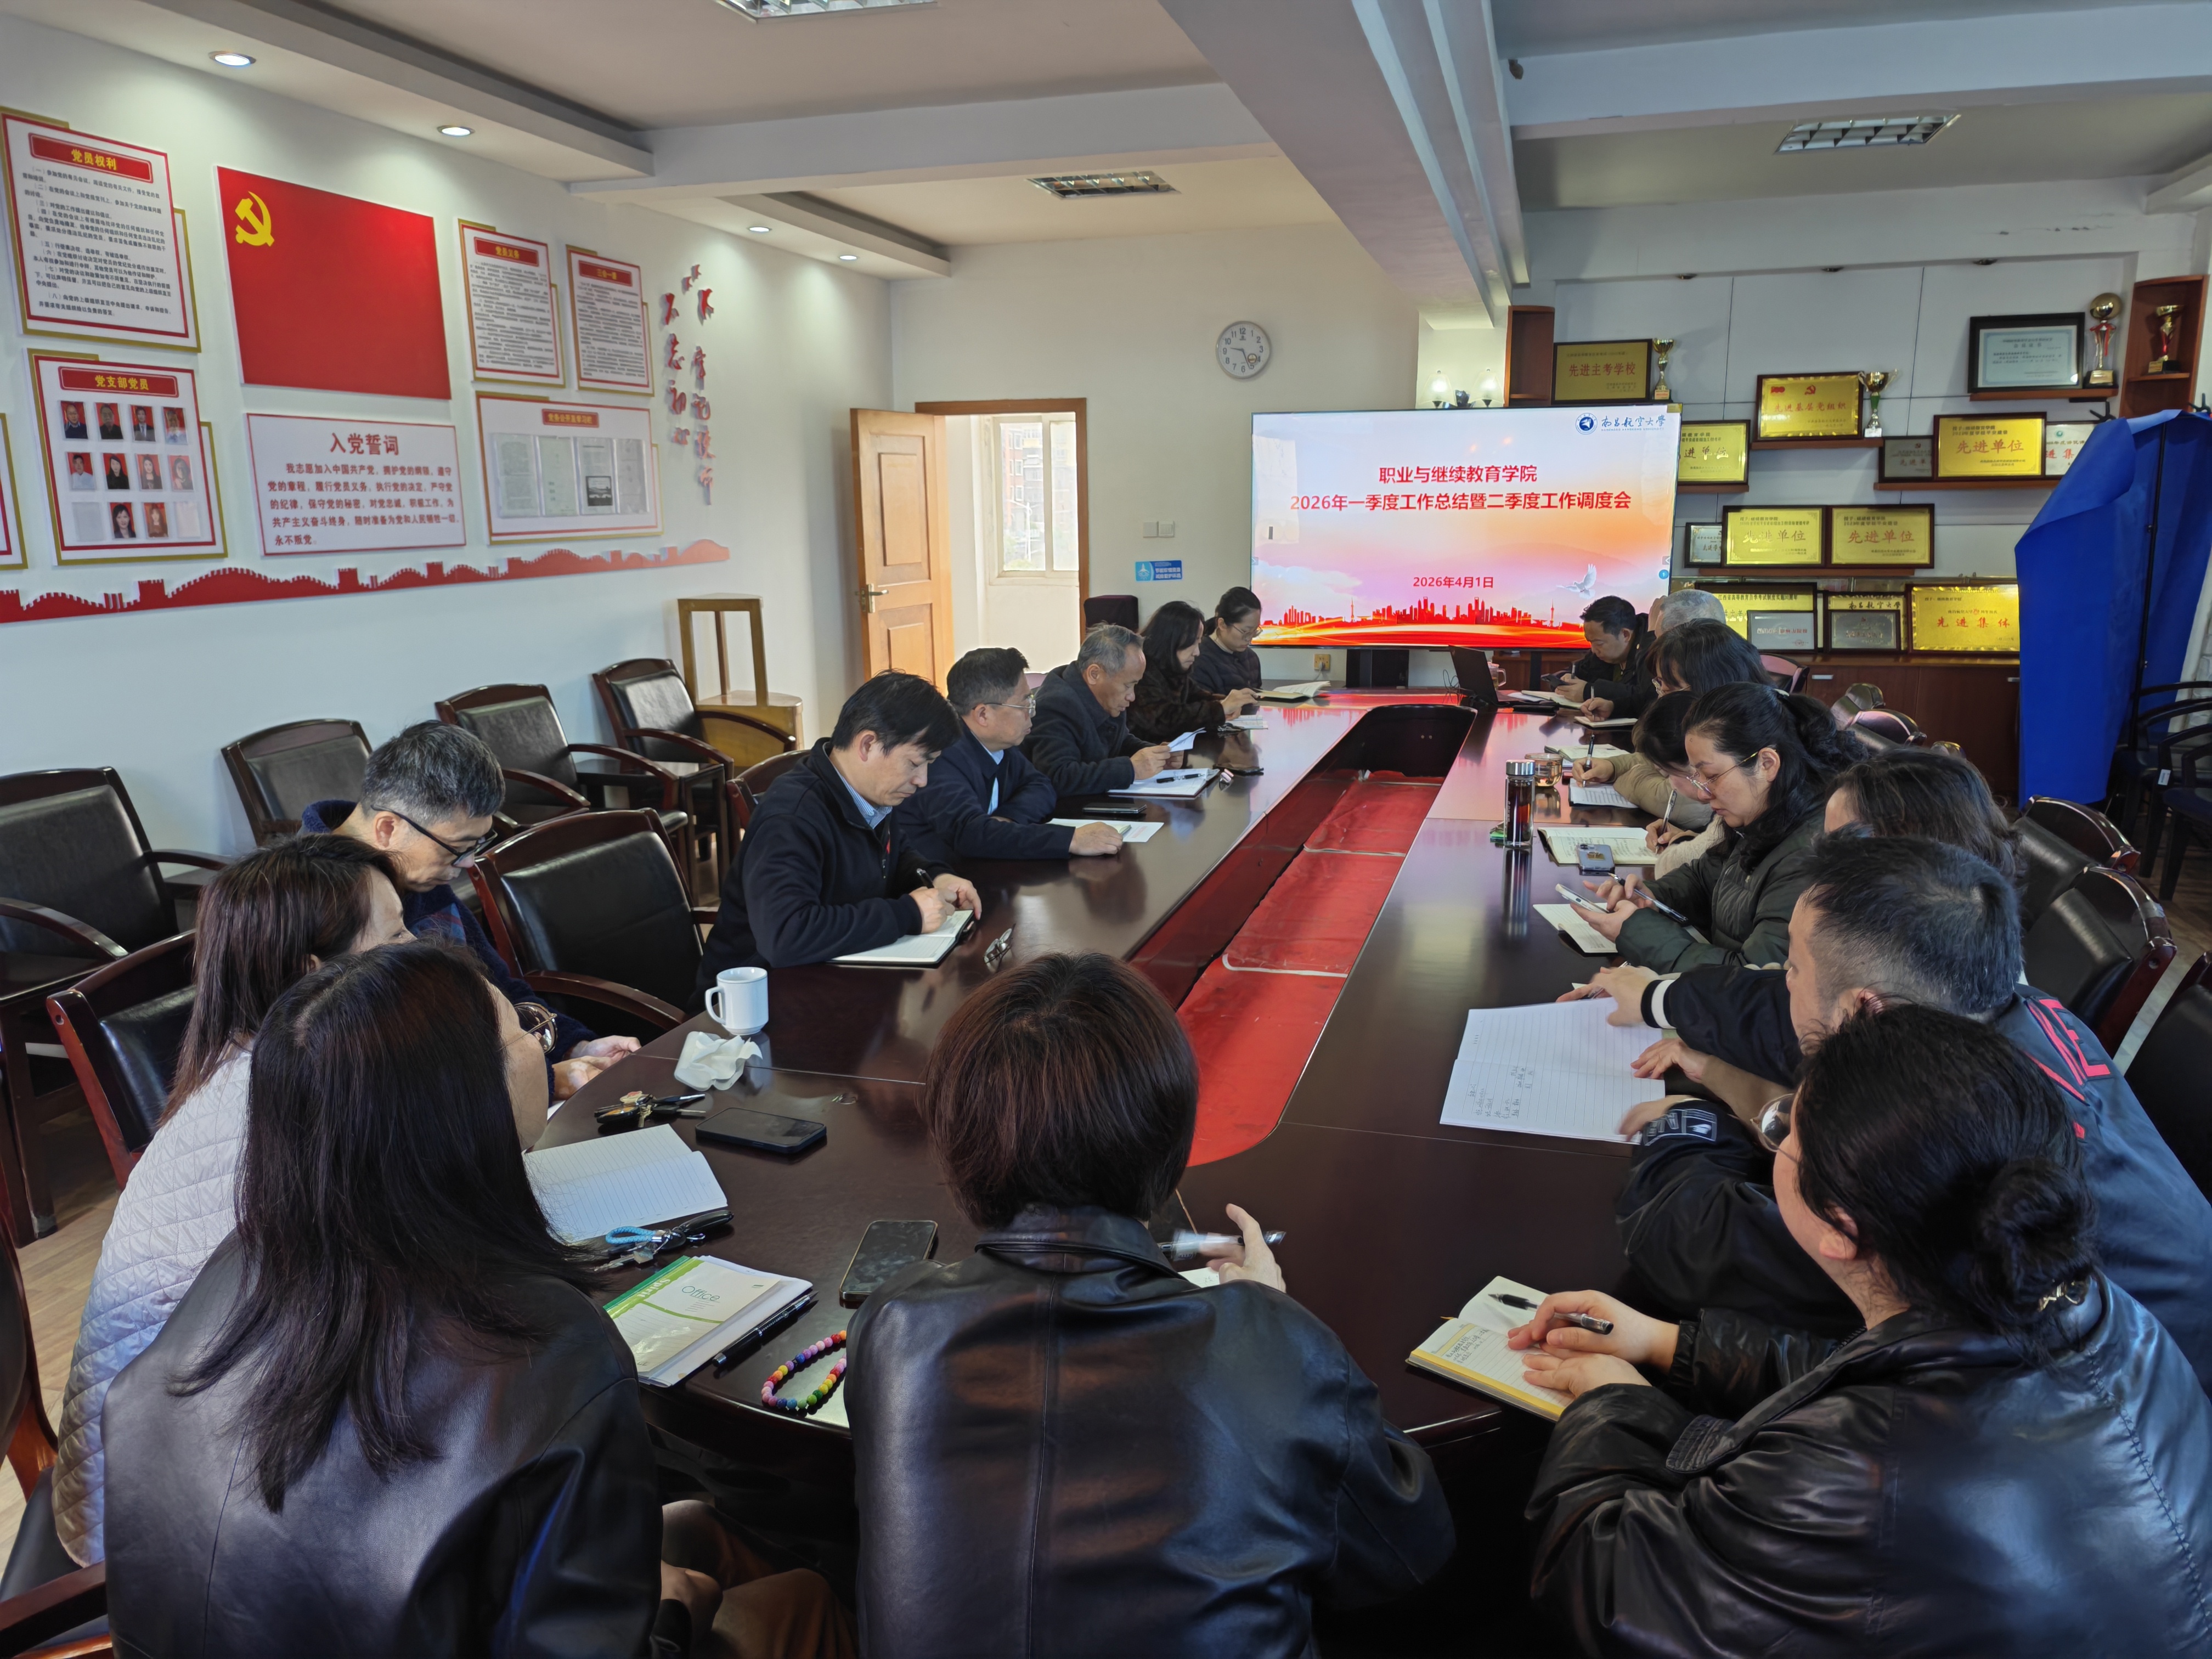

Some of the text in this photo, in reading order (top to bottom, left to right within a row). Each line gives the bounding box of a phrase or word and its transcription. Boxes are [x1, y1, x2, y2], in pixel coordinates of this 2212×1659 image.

[71, 149, 117, 171] 党员权利
[1569, 362, 1635, 377] 先进主考学校
[95, 375, 149, 391] 党支部党员
[1774, 402, 1847, 413] 先进基层党组织
[330, 432, 399, 455] 入党誓词
[1956, 439, 2024, 454] 先进单位
[1379, 464, 1538, 485] 职业与继续教育学院
[1290, 491, 1632, 513] 2026年一季度工作总结暨二季度工作调度会
[1743, 529, 1806, 543] 先进单位
[1848, 529, 1915, 544] 先进单位
[1413, 576, 1494, 589] 2026年4月1日
[1937, 616, 2010, 628] 先进集体
[637, 1278, 670, 1298] Spirit
[681, 1285, 720, 1302] Office
